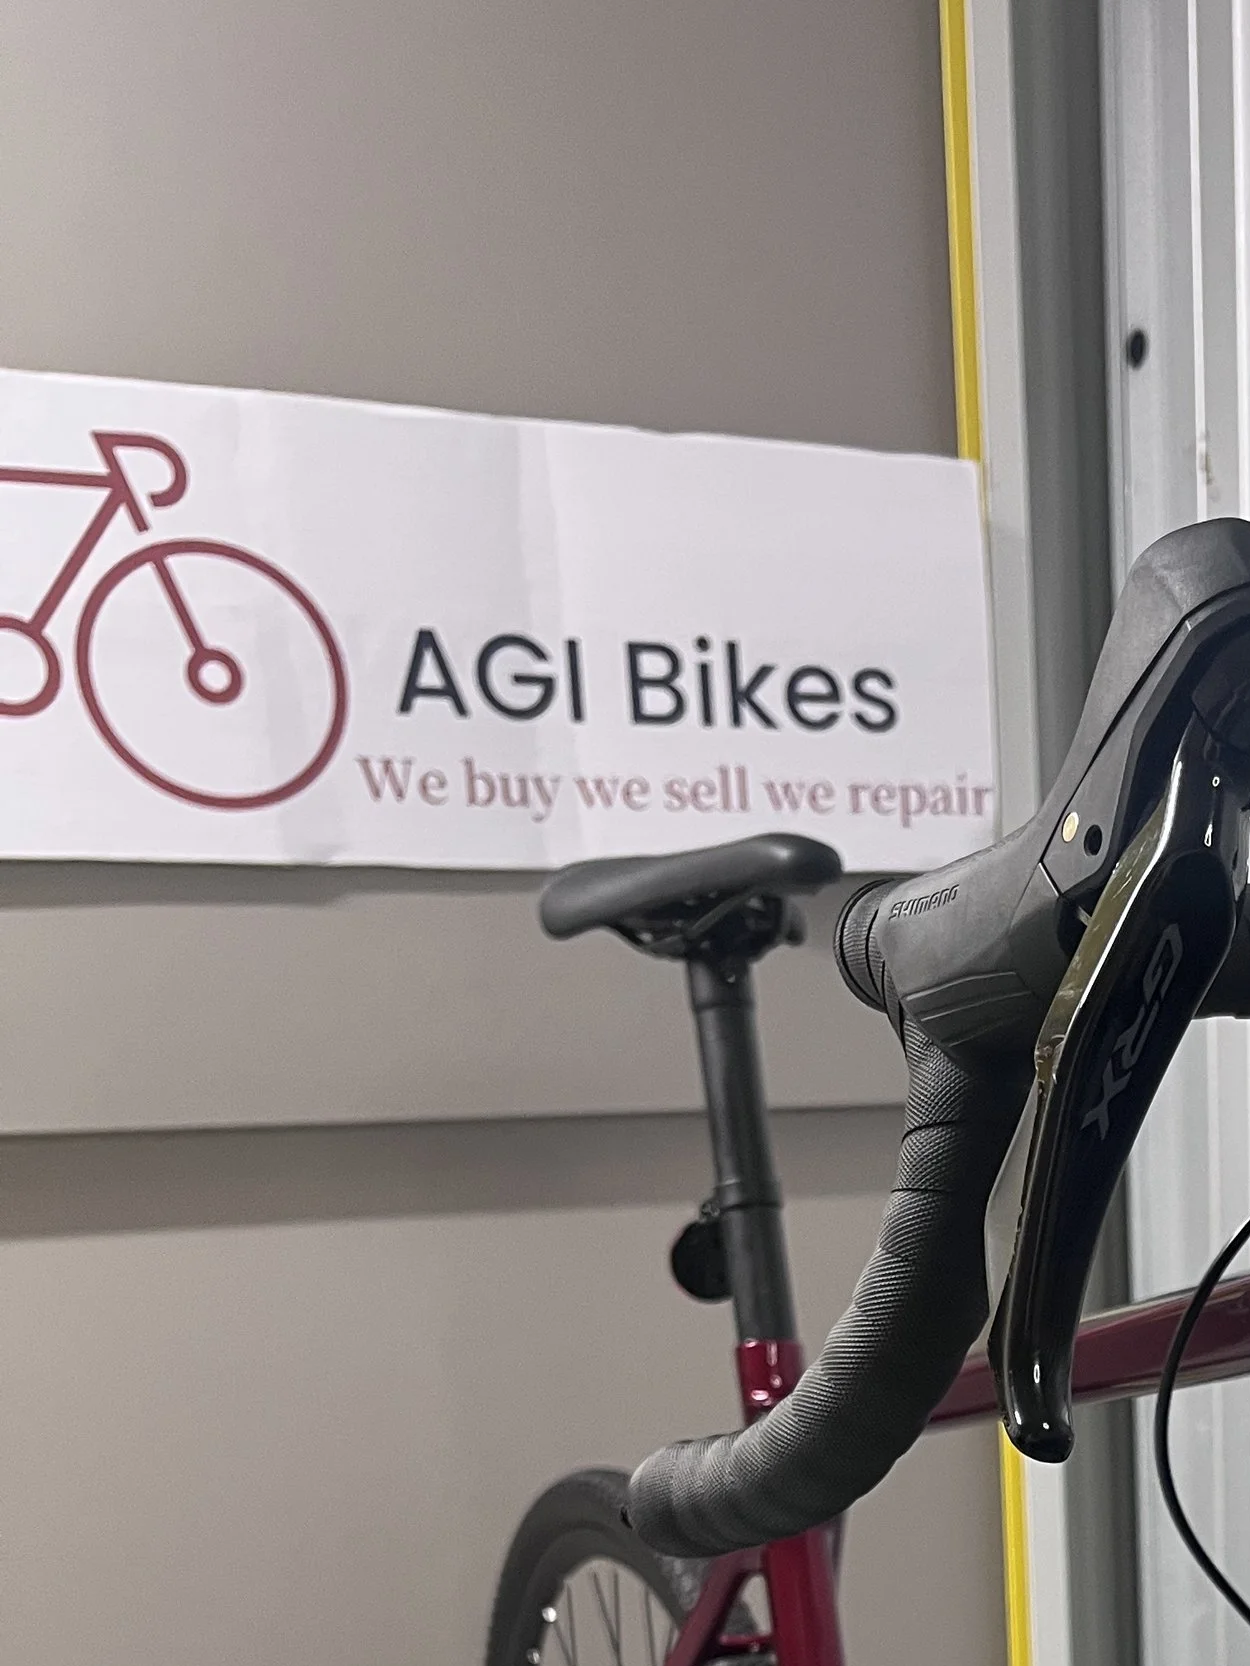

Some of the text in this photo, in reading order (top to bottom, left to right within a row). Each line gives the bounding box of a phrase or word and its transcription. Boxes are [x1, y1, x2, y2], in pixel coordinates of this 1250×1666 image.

[396, 628, 898, 733] AGI Bikes
[355, 755, 993, 828] We buy we sell we repair
[888, 884, 960, 920] SHIMANO
[1080, 922, 1184, 1141] GRX
